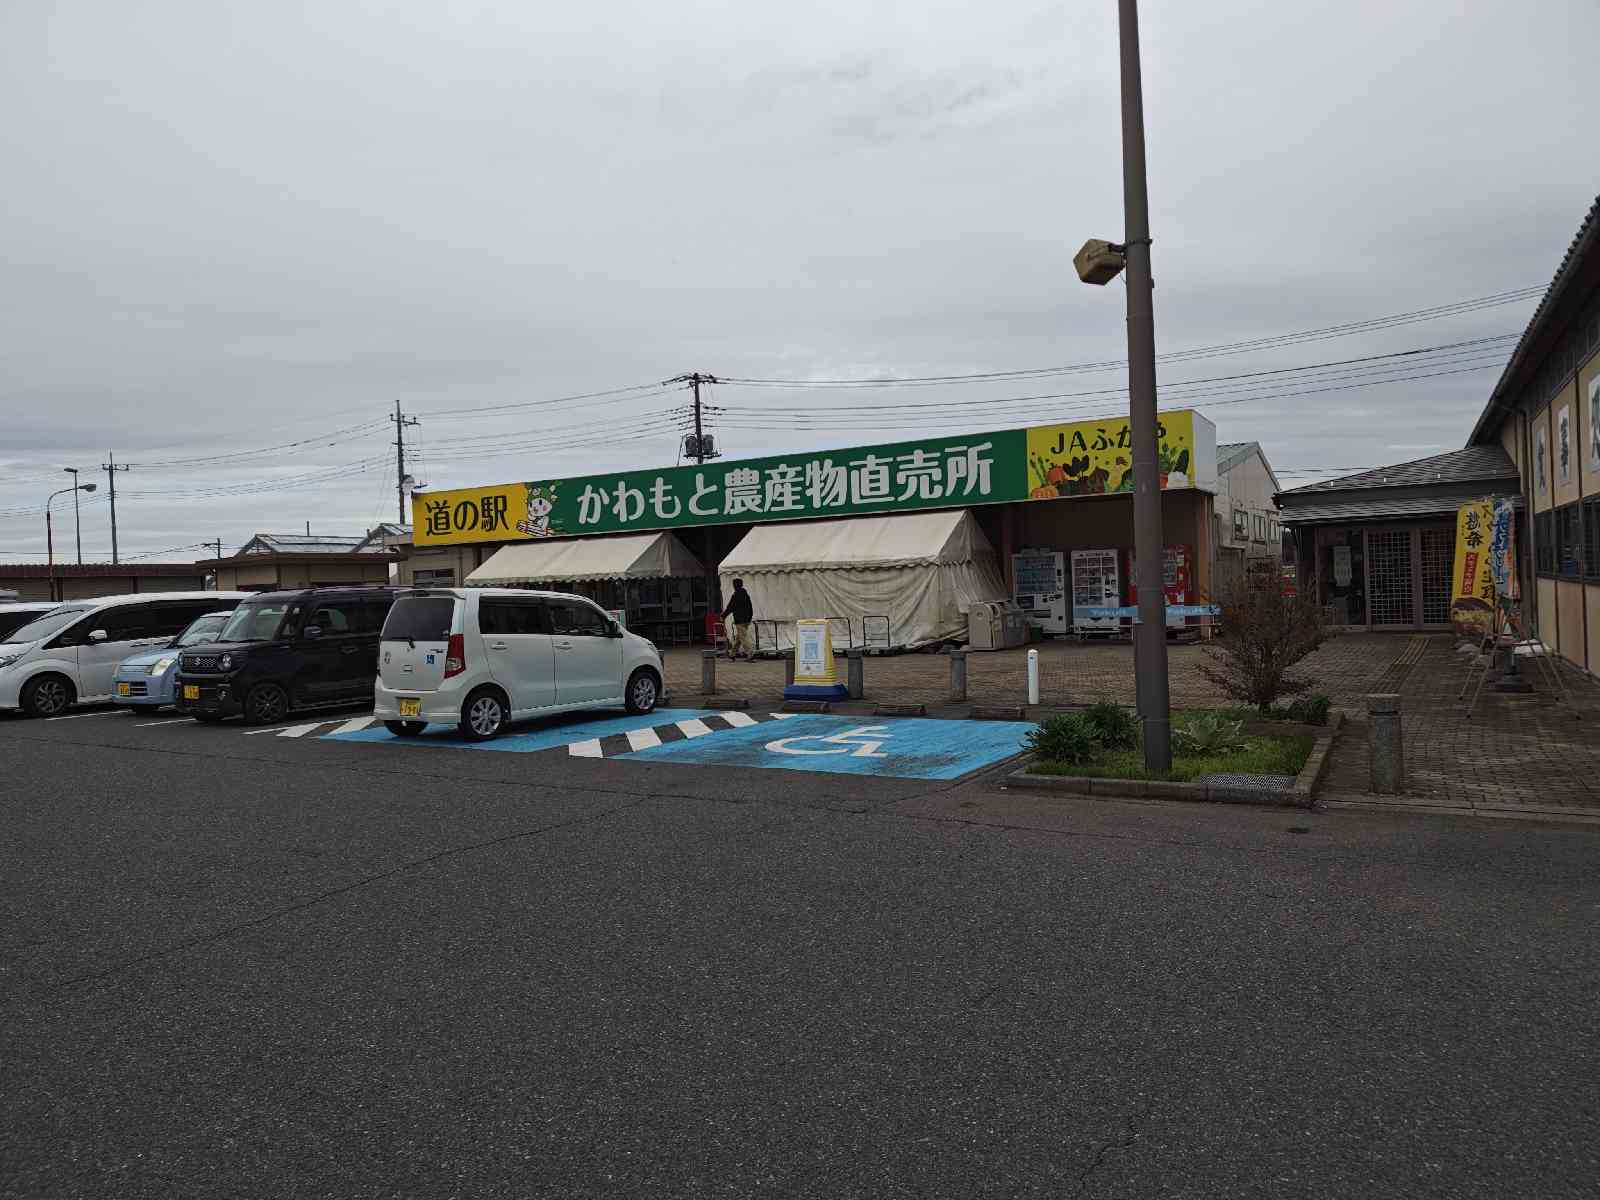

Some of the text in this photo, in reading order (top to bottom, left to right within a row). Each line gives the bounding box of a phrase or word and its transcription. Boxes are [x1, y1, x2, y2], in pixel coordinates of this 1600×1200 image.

[577, 441, 994, 525] かわもと農産物直売所
[425, 495, 509, 536] 道の駅
